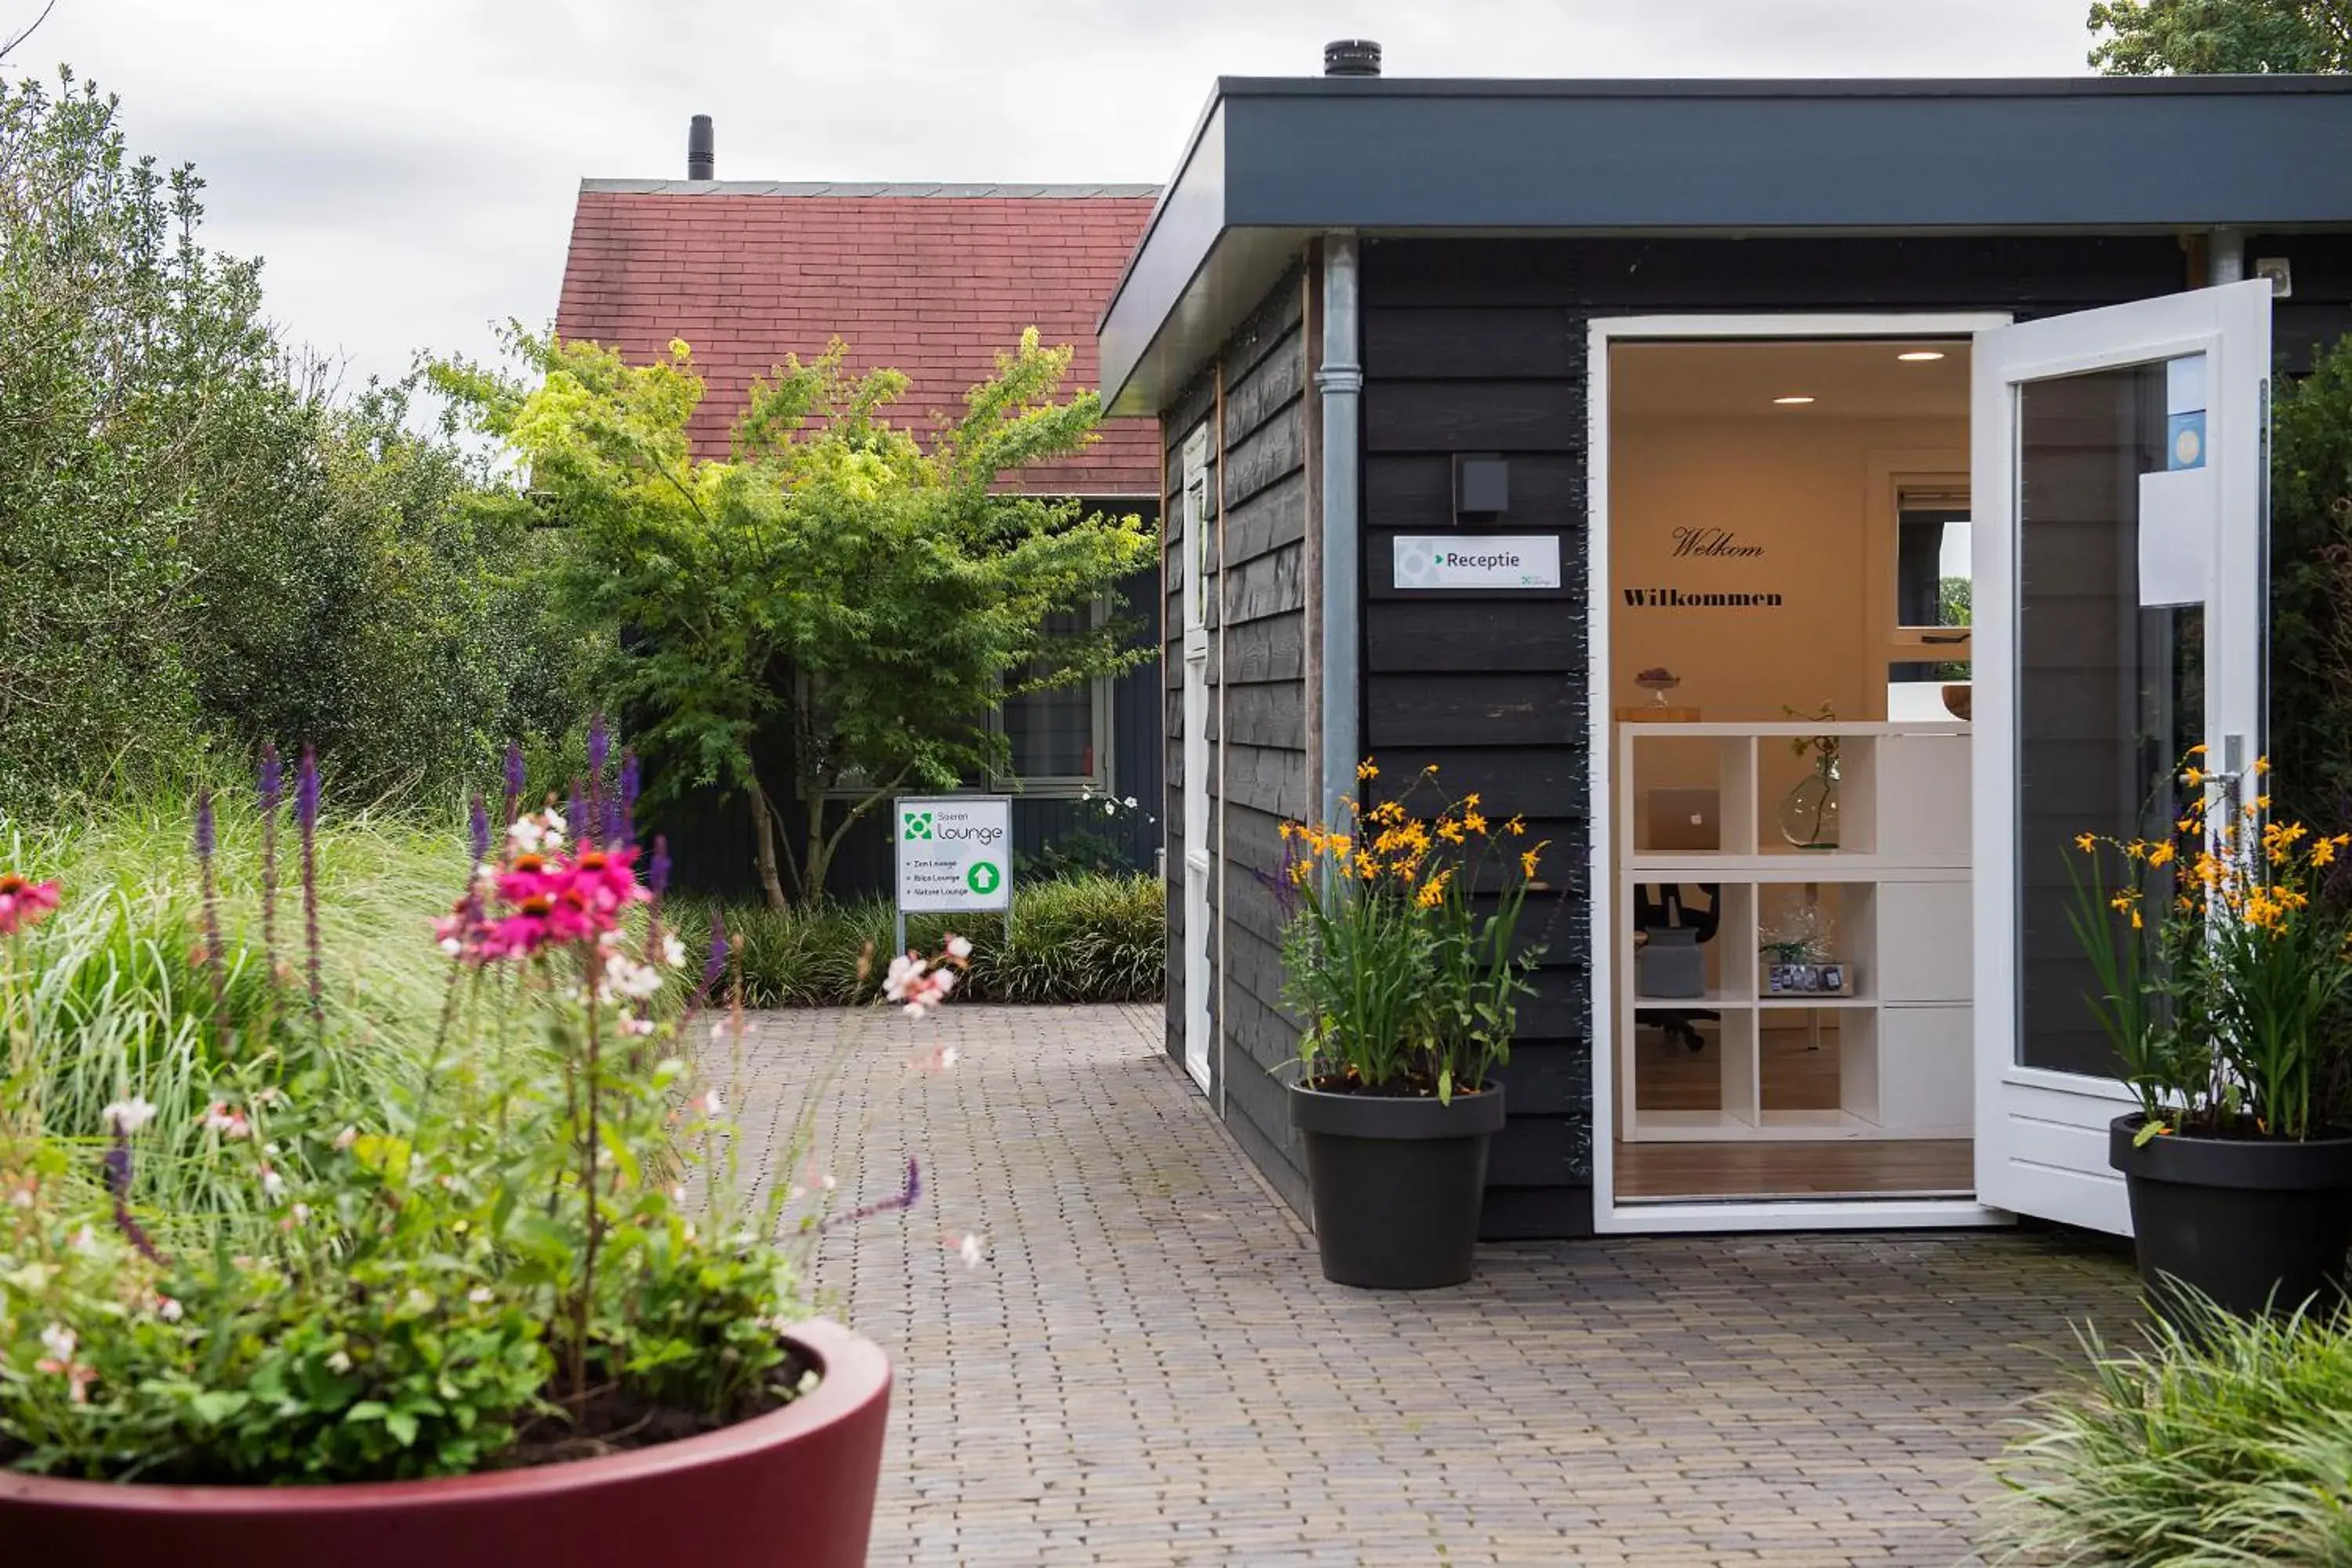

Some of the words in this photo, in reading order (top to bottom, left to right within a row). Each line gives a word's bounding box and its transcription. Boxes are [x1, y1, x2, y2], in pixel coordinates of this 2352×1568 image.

[1671, 526, 1765, 557] Welkom
[1447, 552, 1519, 571] Receptie
[1624, 589, 1782, 607] Wilkommen
